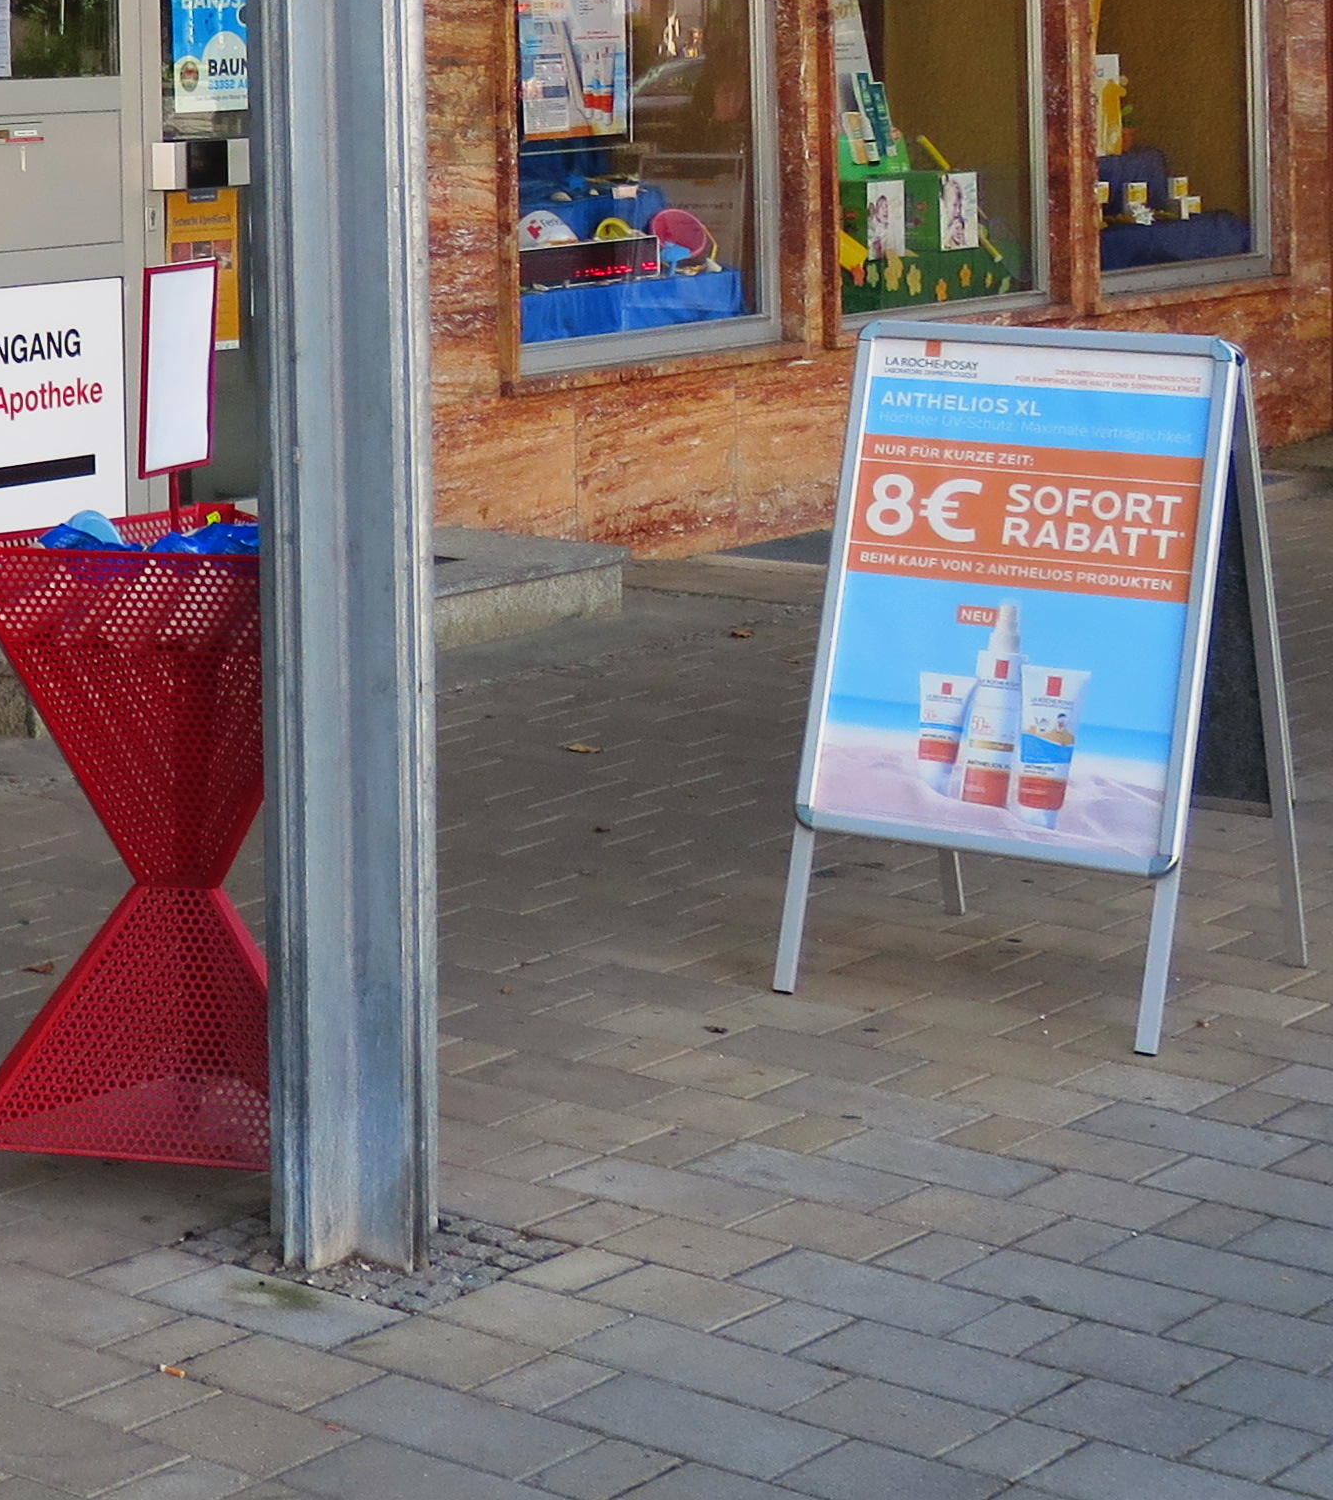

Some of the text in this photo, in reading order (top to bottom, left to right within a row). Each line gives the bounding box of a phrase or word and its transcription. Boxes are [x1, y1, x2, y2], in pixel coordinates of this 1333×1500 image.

[900, 358, 979, 371] ROCHE-POSAY
[881, 390, 1042, 417] ANTHELIOS XL
[1021, 420, 1087, 437] Maximale
[874, 442, 1035, 467] NUR FÜR KURZE ZEIT:
[865, 473, 1182, 544] 8€ SOFORT
[860, 551, 1173, 592] BEIM KAUF VON 2 ANTHELIOS PRODUKTEN
[959, 608, 994, 623] NEU
